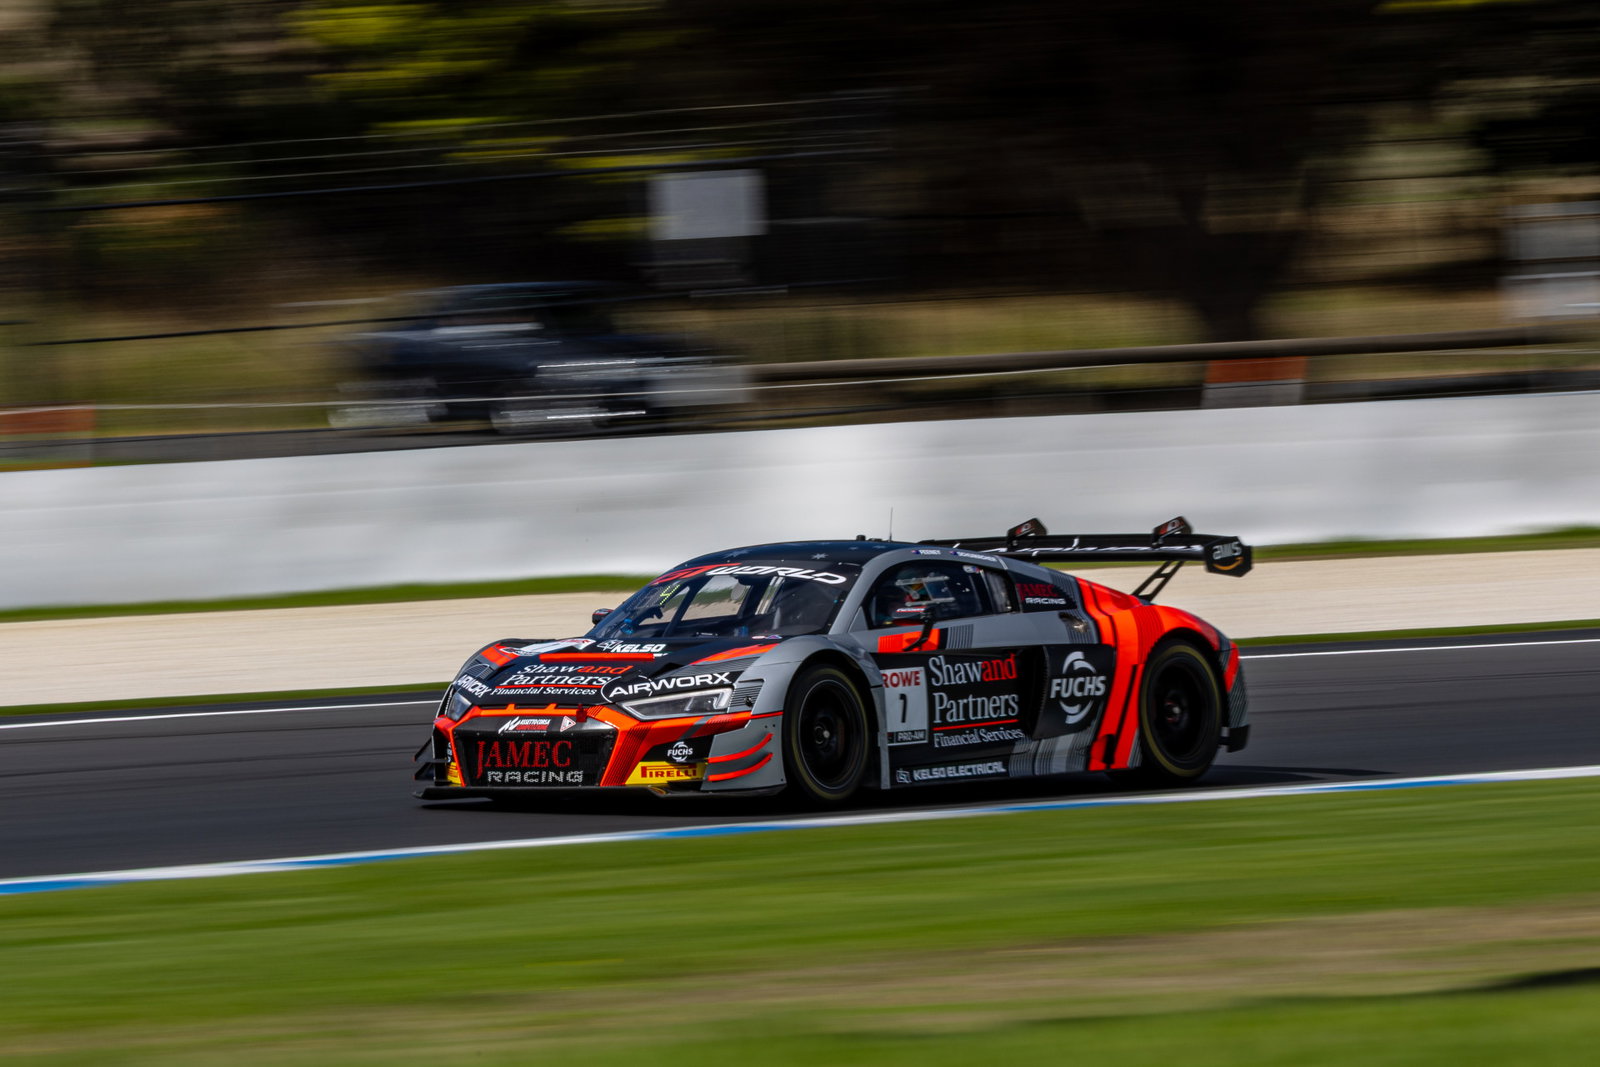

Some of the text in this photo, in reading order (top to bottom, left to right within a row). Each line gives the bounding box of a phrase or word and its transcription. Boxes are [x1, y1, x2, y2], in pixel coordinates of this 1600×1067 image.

[1025, 596, 1067, 606] RACING
[610, 643, 668, 653] KELSO
[500, 674, 614, 686] Partners
[608, 671, 731, 698] AIRWORX
[881, 670, 922, 689] ROWE
[1050, 675, 1107, 699] FUCHS
[490, 686, 598, 696] Financial Services
[932, 692, 1020, 724] Partners
[933, 727, 1025, 748] Financial Services
[475, 740, 573, 778] JAMEC
[667, 747, 694, 757] FUCHS
[487, 770, 584, 783] RACING
[640, 763, 697, 778] PIRELLI
[913, 761, 1006, 781] KELSO ELECTRICAL
